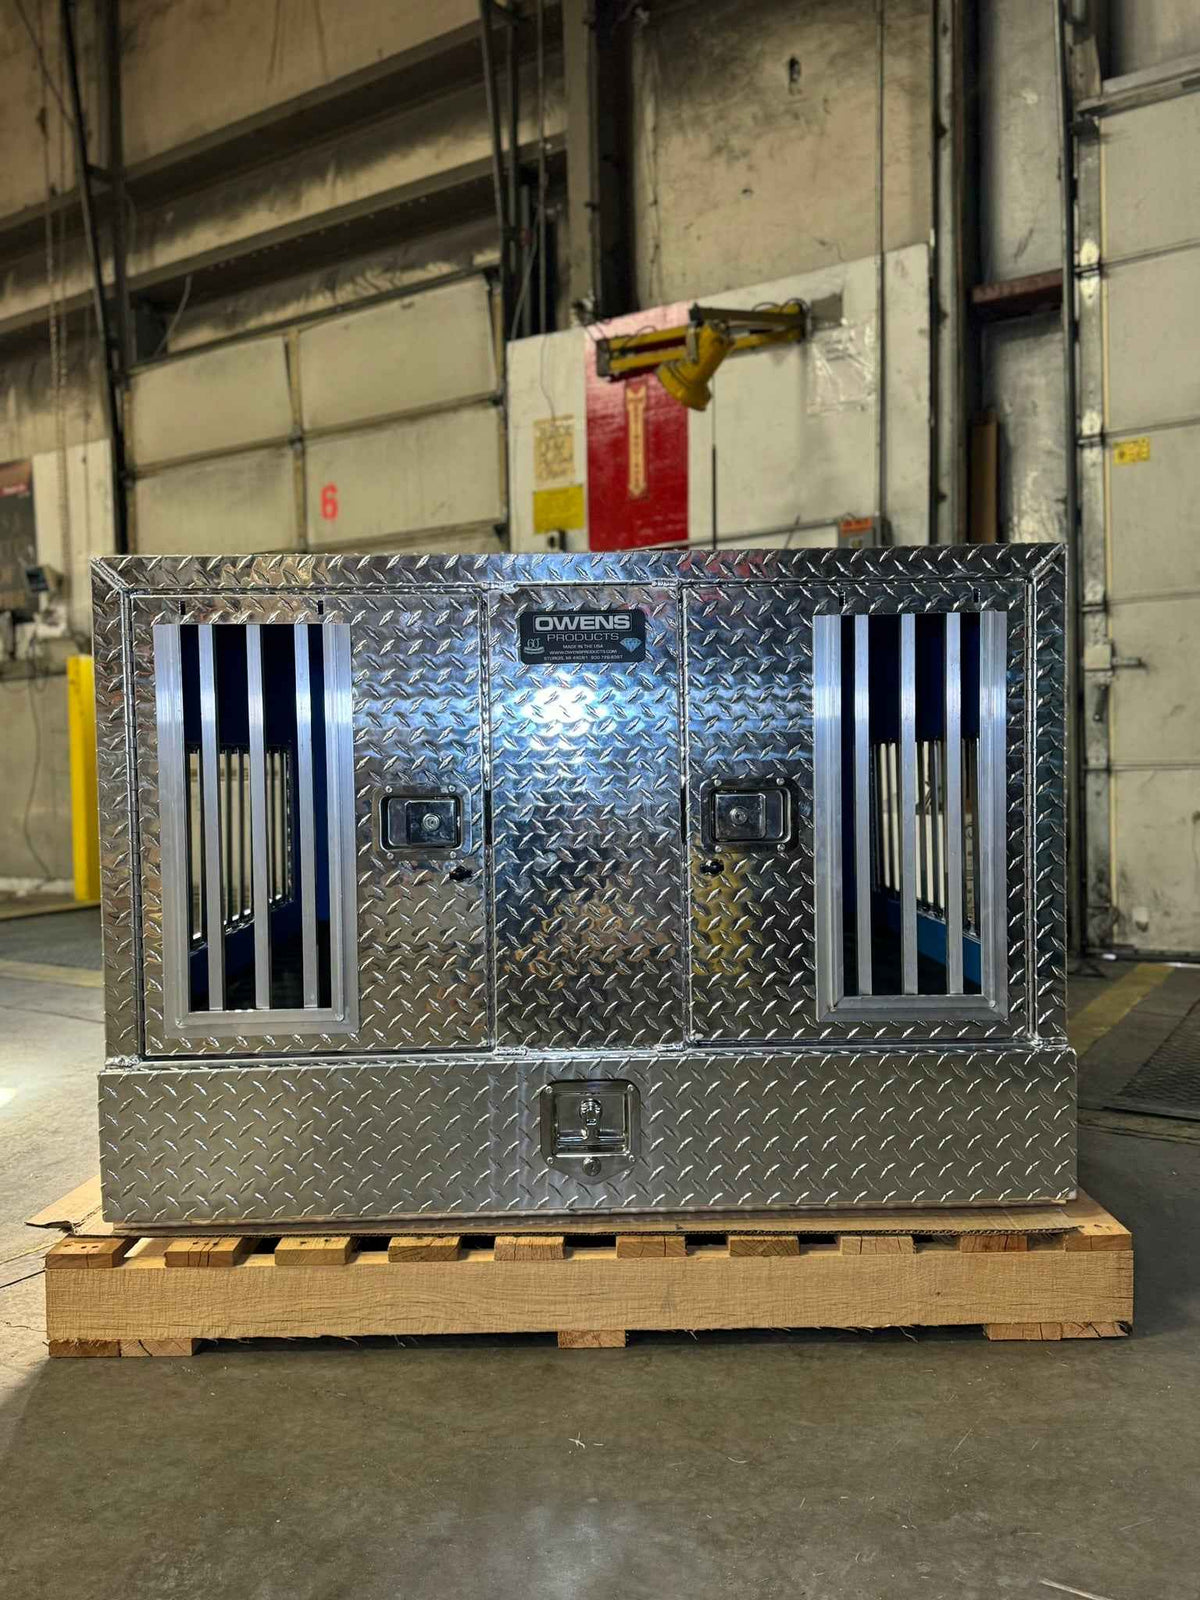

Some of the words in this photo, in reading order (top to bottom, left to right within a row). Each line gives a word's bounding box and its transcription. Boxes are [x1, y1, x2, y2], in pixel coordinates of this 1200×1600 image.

[321, 484, 338, 521] 6
[535, 615, 630, 631] OWENS
[547, 633, 619, 642] PRODUCTS
